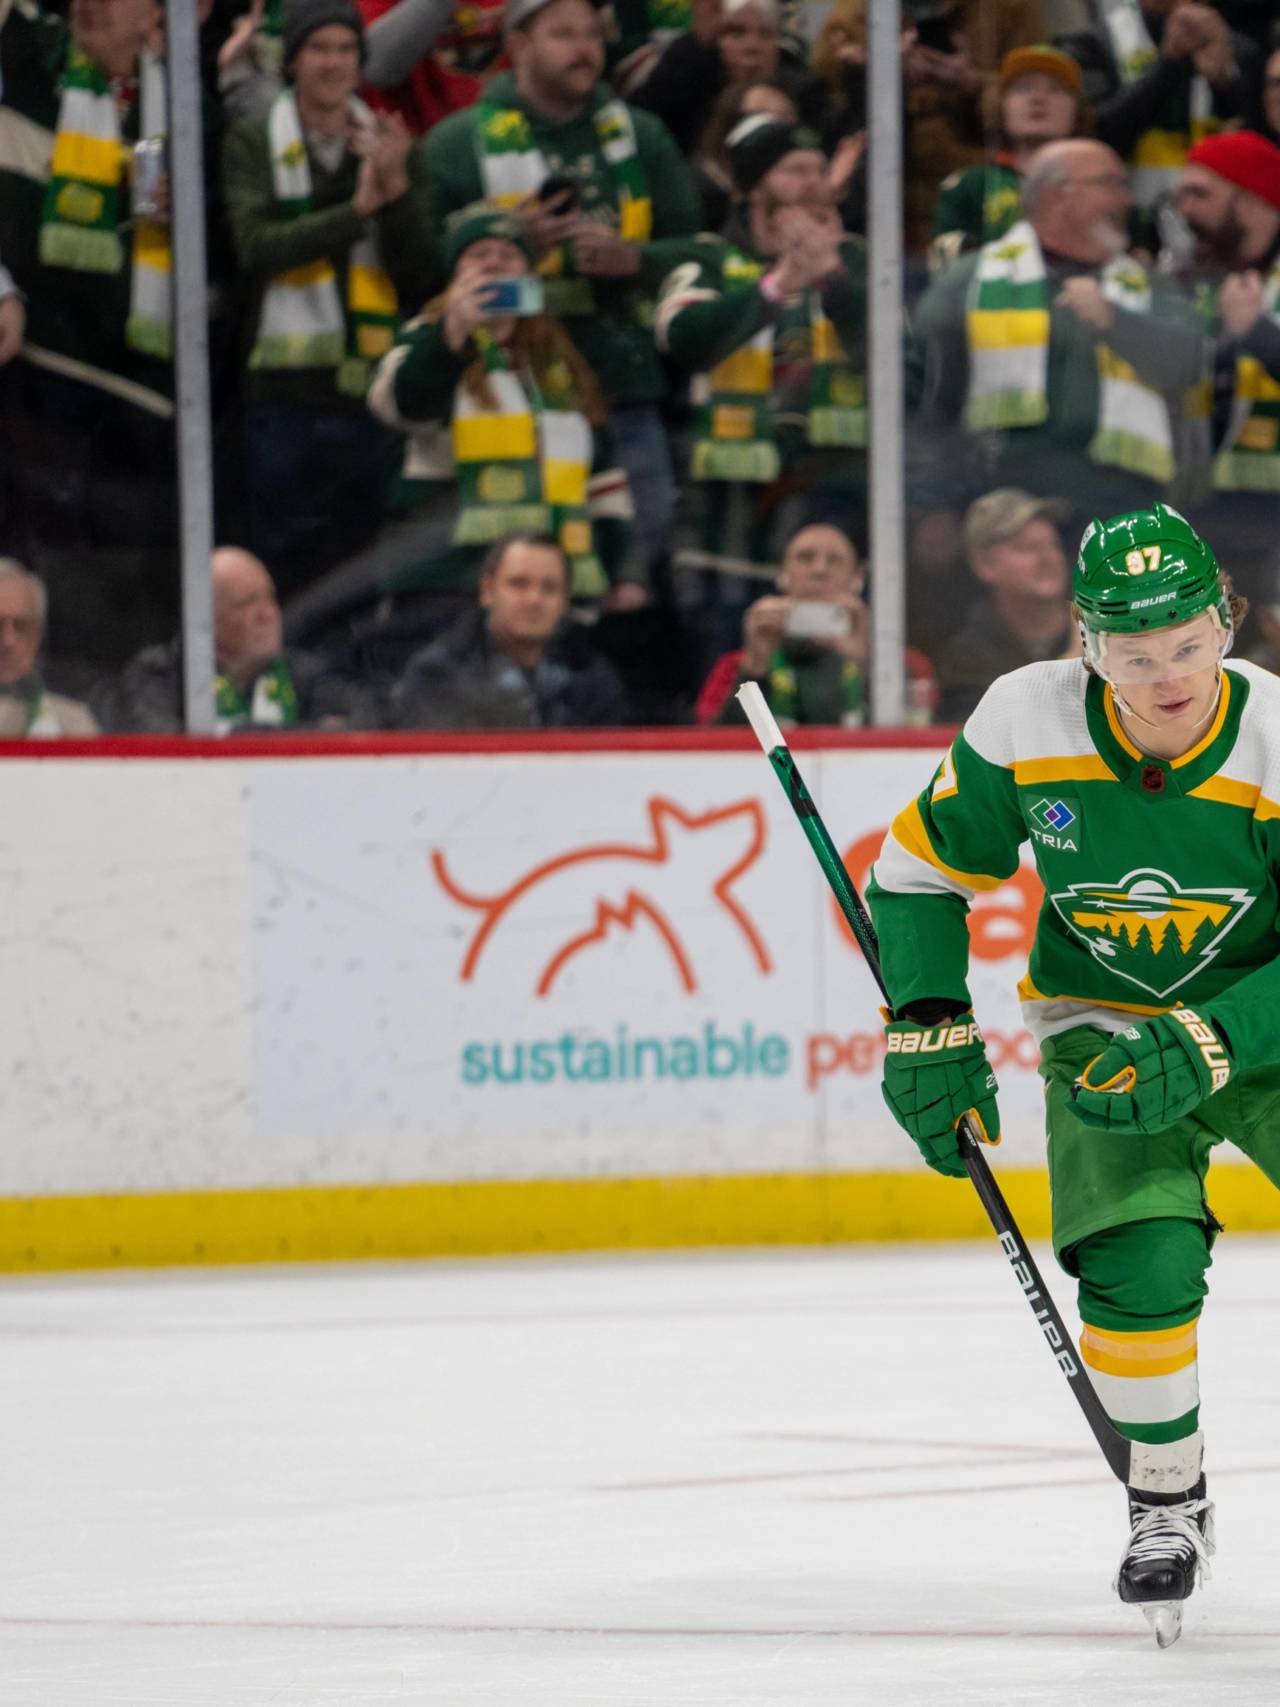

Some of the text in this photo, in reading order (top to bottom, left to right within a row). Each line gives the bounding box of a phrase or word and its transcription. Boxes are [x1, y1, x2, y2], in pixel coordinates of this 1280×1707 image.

[1125, 544, 1161, 576] 97
[1130, 591, 1178, 611] BAUER
[1029, 827, 1078, 852] TRIA
[887, 1022, 983, 1054] BAUER
[460, 1020, 792, 1084] sustainable
[804, 1030, 889, 1092] pe
[998, 1229, 1079, 1379] BAUER
